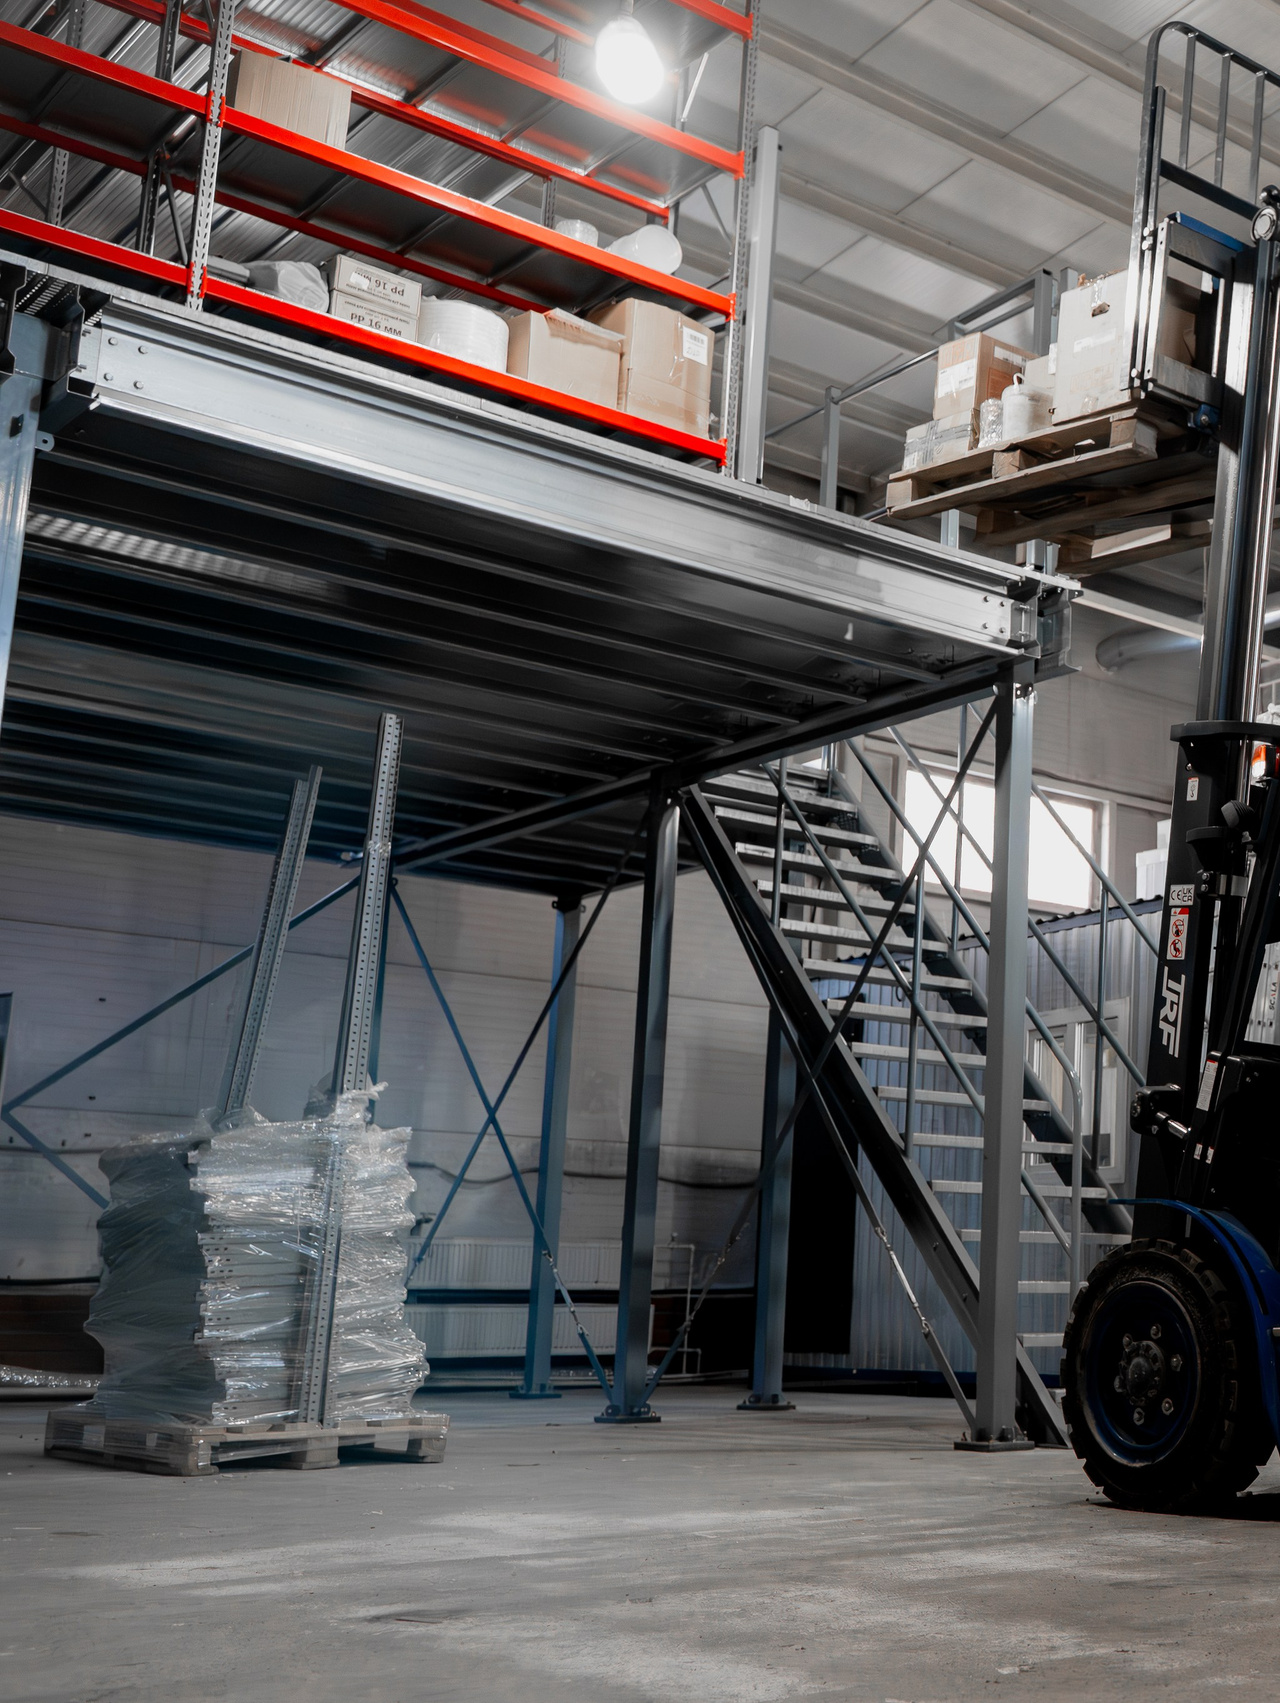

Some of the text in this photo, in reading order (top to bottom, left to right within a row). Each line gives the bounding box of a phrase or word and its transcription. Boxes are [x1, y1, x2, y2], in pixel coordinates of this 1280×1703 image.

[375, 279, 387, 290] 16
[369, 318, 381, 329] 16
[1171, 889, 1182, 901] CE
[1182, 887, 1193, 895] UK
[1159, 965, 1186, 1058] TRF
